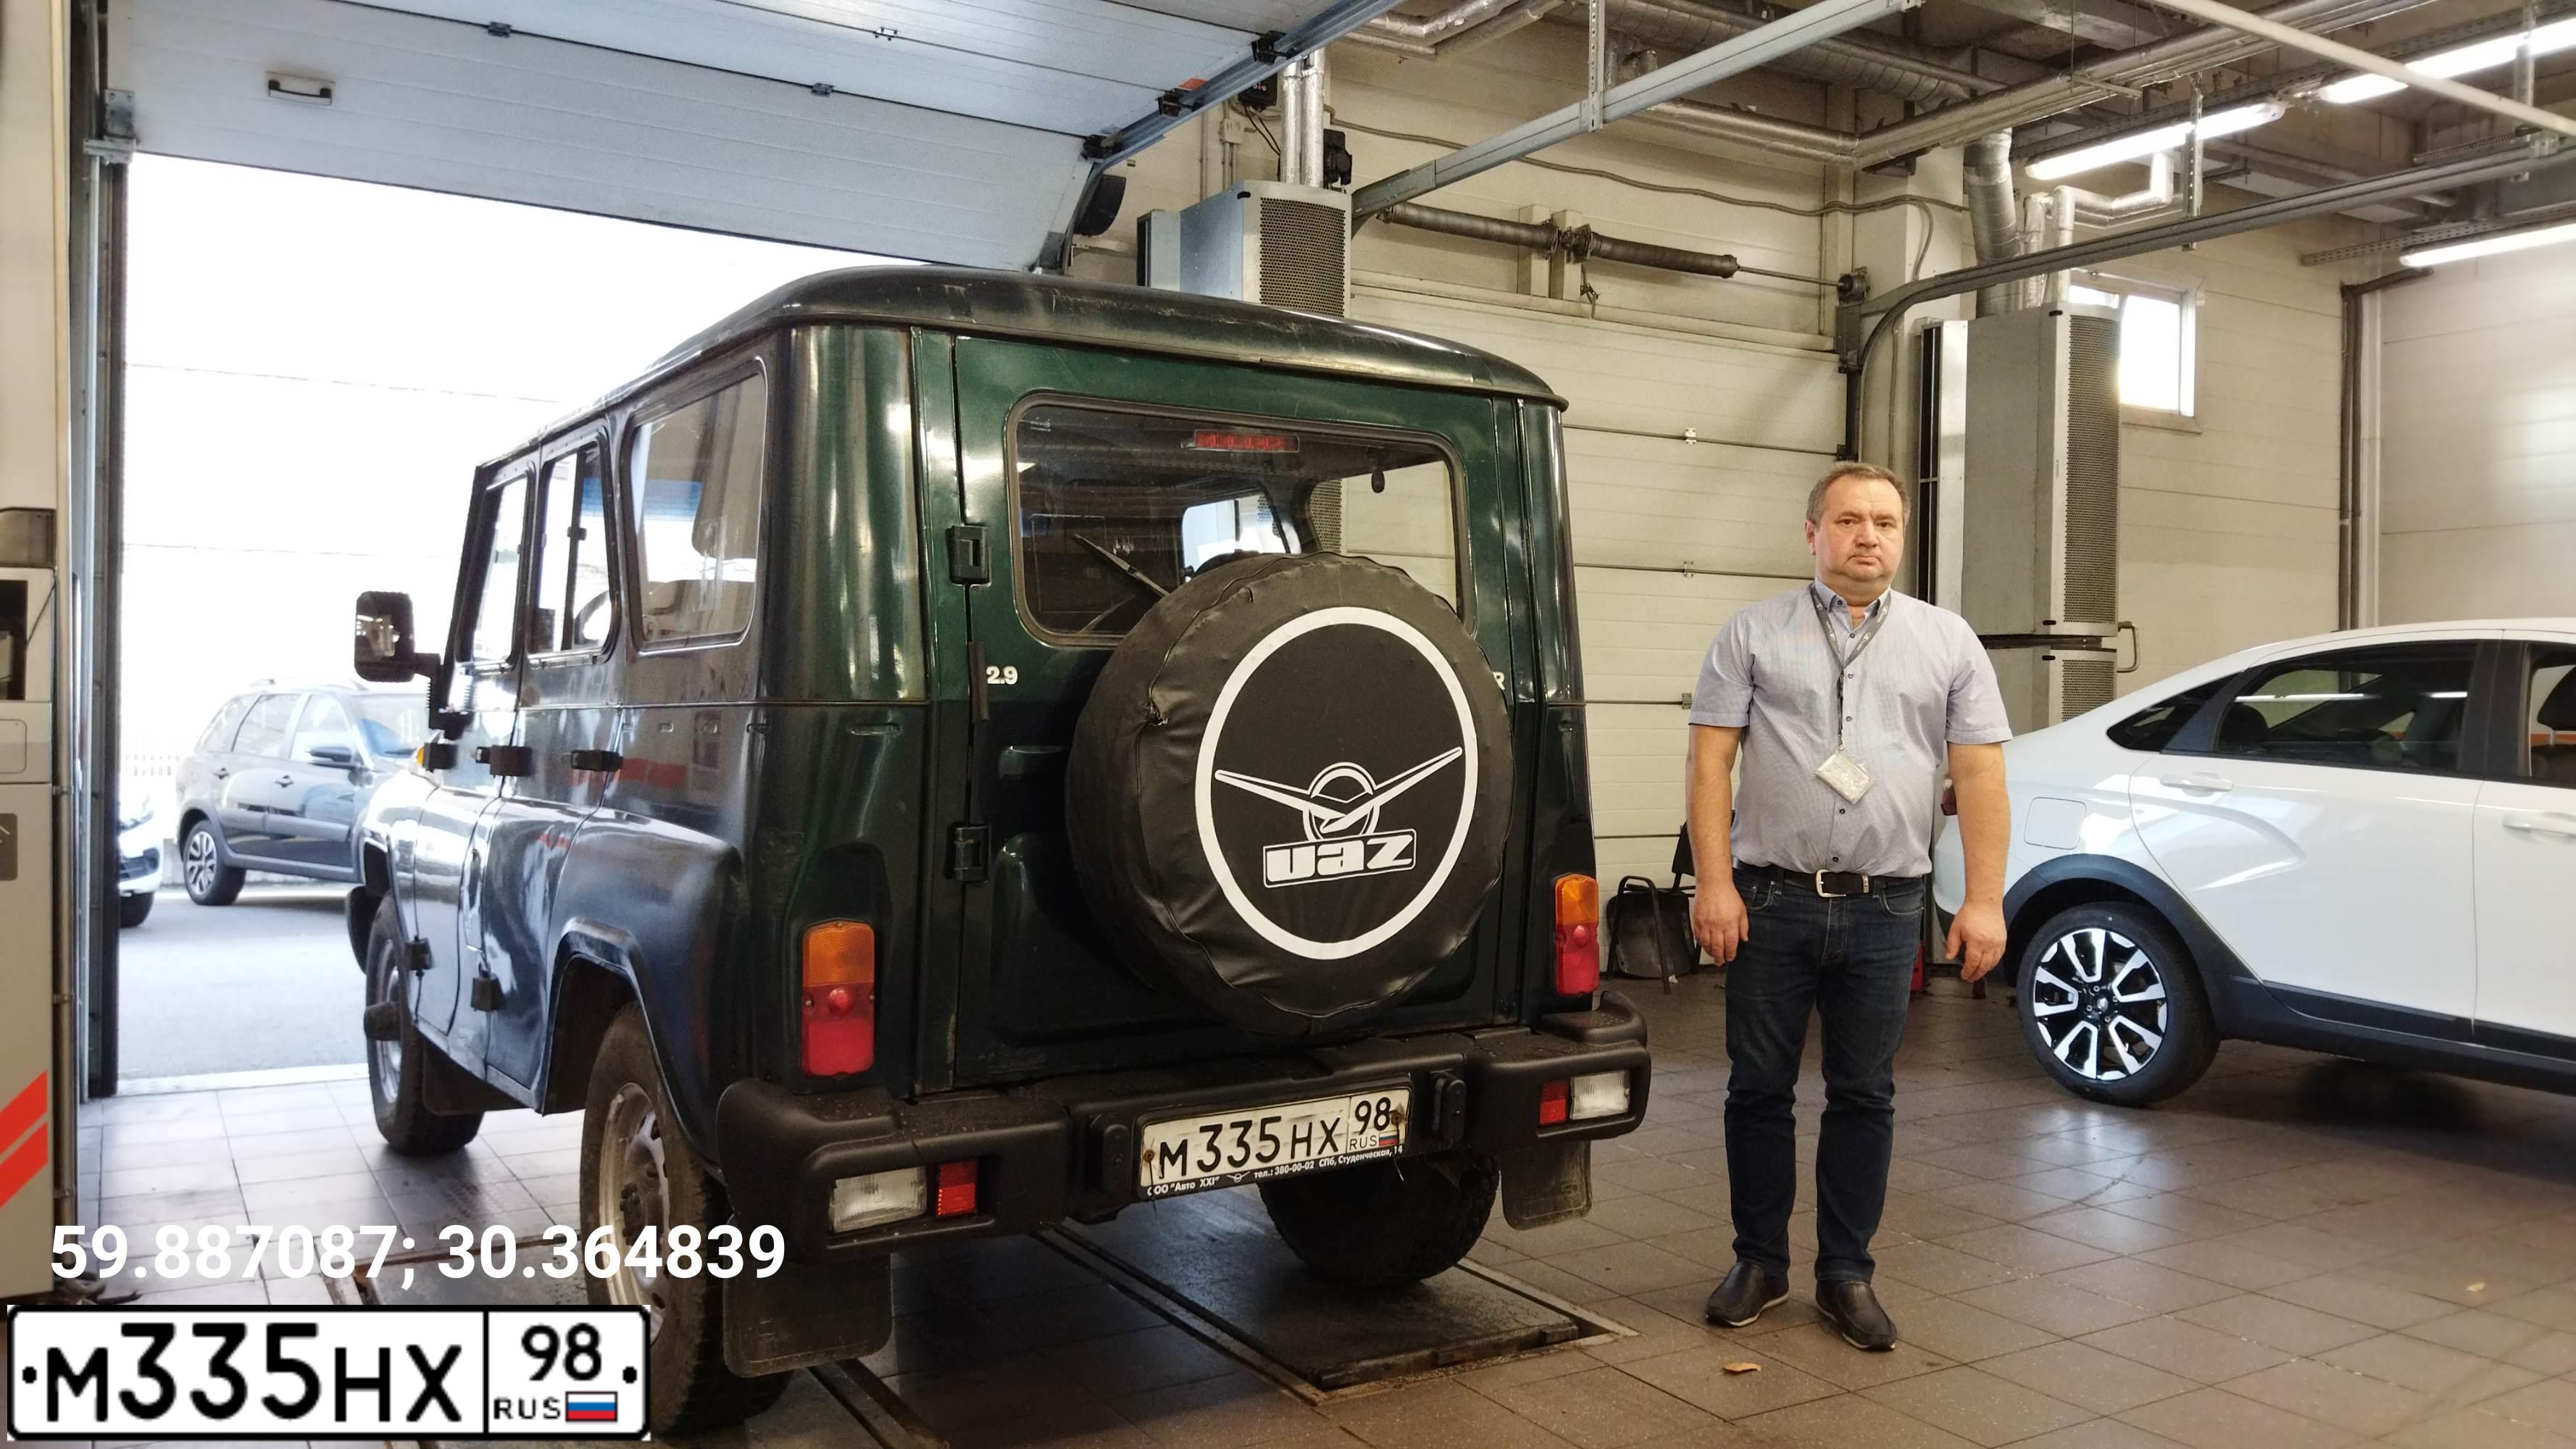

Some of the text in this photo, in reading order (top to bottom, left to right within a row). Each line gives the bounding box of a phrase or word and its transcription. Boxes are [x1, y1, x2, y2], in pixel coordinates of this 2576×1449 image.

[986, 665, 1018, 685] 2.9
[1354, 1096, 1391, 1135] 98
[1349, 1135, 1377, 1151] RUS
[1274, 1160, 1314, 1176] 380-00-02
[1393, 1145, 1403, 1154] 14
